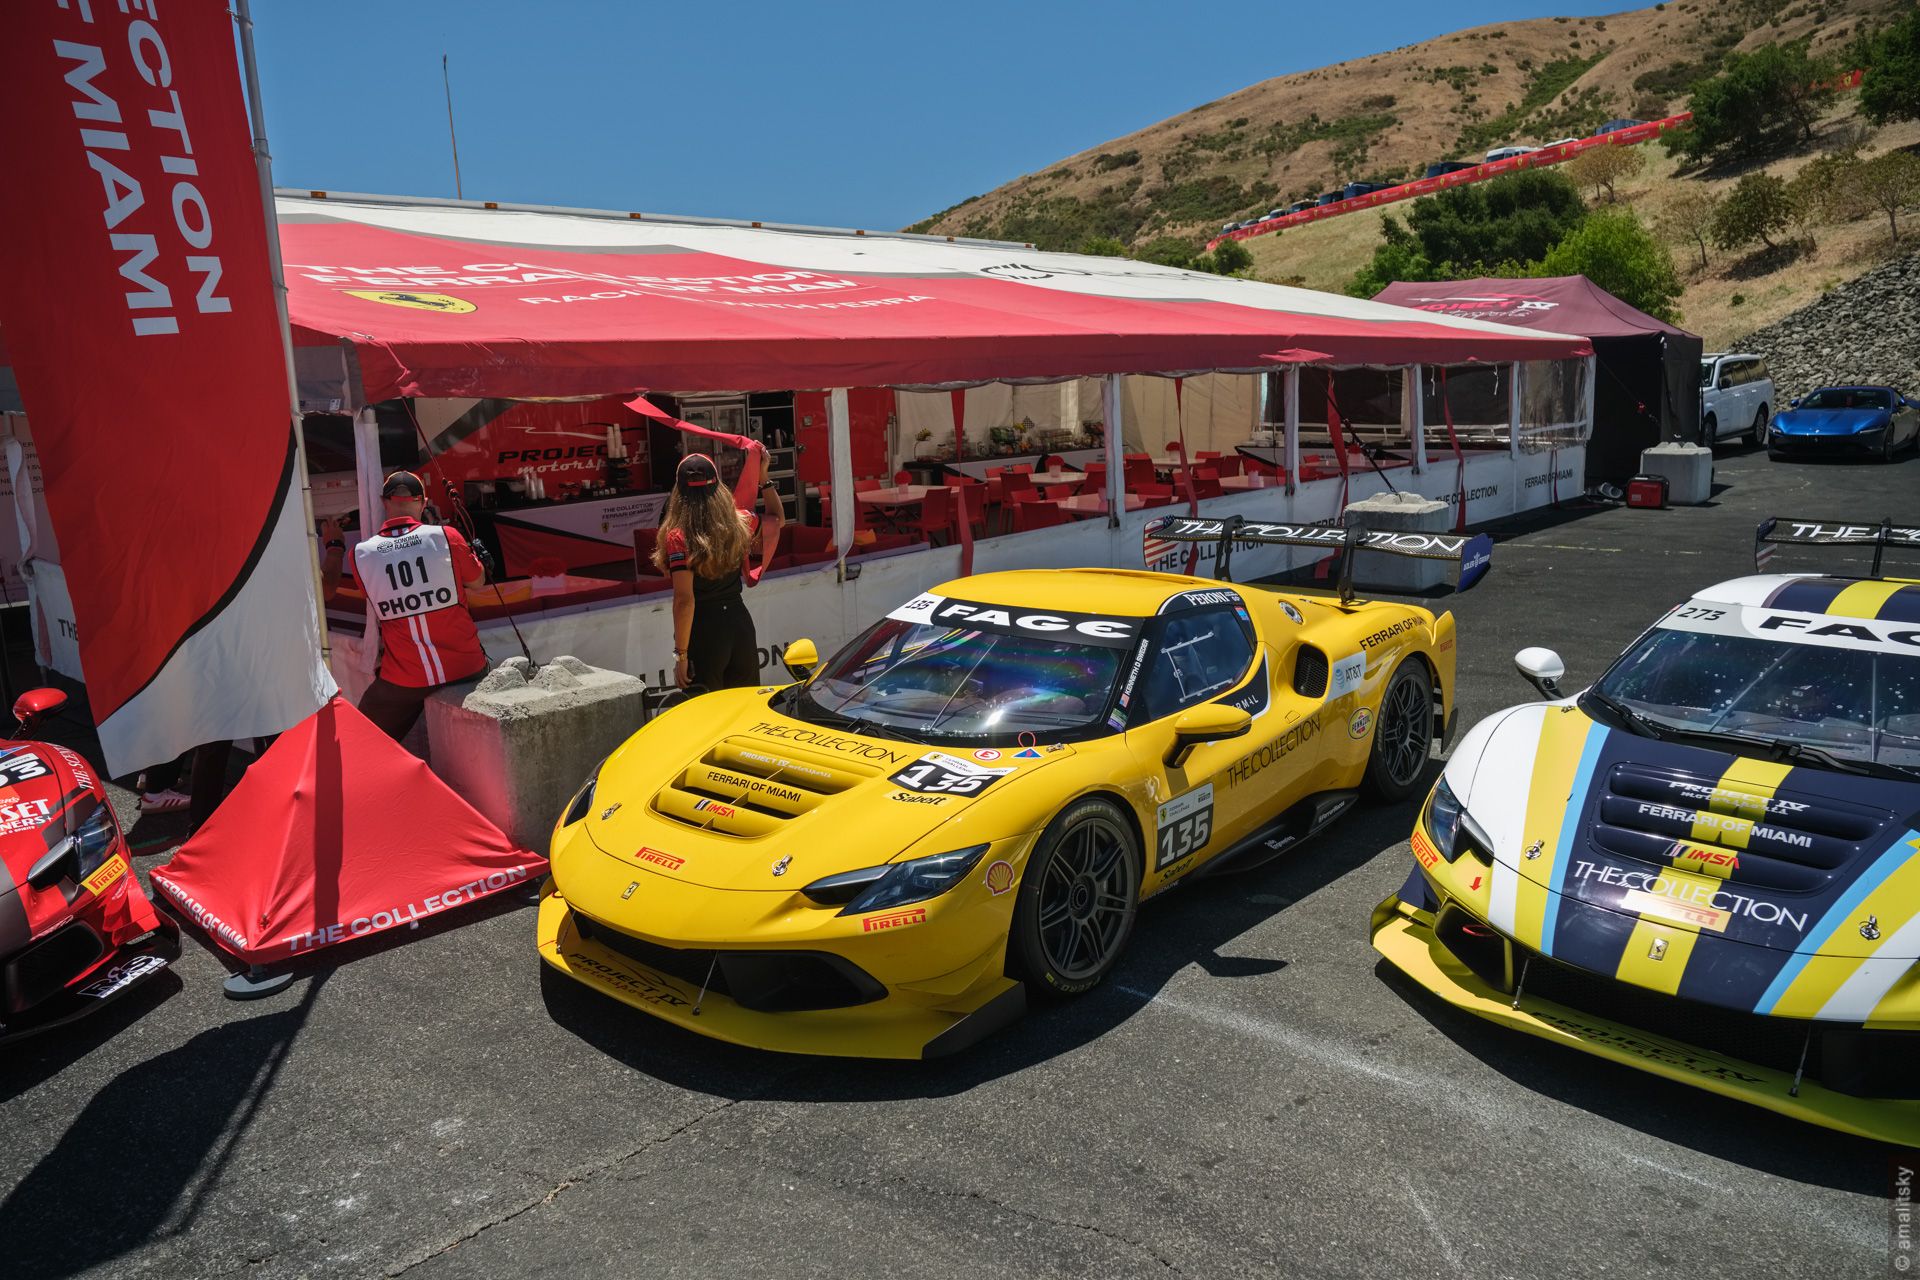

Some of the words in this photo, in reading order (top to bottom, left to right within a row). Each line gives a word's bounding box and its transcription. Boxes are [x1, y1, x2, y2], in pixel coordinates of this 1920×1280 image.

[52, 39, 180, 336] MIAMI
[498, 444, 632, 464] PROJEC
[1525, 474, 1546, 489] FERRARI
[1451, 485, 1498, 505] COLECTION
[394, 534, 419, 545] SONOMA
[1792, 523, 1870, 538] THE
[394, 538, 423, 550] RACEWAY
[1180, 541, 1264, 567] CLLTION
[385, 556, 429, 591] 101
[377, 587, 452, 617] PHOTO
[904, 599, 935, 611] 135
[1183, 591, 1230, 606] PERONI
[938, 603, 1132, 638] FAGE
[1677, 607, 1727, 621] 273
[1359, 622, 1404, 651] FERRARI
[1403, 618, 1413, 630] OF
[1125, 665, 1140, 696] KENNETH
[1345, 664, 1362, 682] AT&T
[739, 751, 778, 765] PROJECT
[980, 750, 994, 758] E
[707, 771, 750, 789] FERRARI
[750, 782, 767, 792] OF
[766, 785, 802, 803] MIAMI
[897, 764, 993, 793] 135
[892, 792, 947, 806] Sabelt
[1667, 781, 1775, 804] PROJECT
[1774, 799, 1811, 812] IV
[706, 802, 735, 819] IMSA
[1160, 810, 1209, 866] 135
[1638, 803, 1718, 828] FERRARI
[1720, 818, 1749, 833] OF
[1751, 825, 1812, 848] MIAMI
[634, 846, 686, 871] PIRELLI
[1411, 831, 1439, 869] PIRELLI
[1687, 849, 1740, 870] IMSA
[88, 858, 124, 891] PIRELLI
[282, 921, 346, 952] THE
[350, 866, 527, 938] COLLECTION
[862, 907, 927, 933] PIRELLI
[569, 953, 660, 995] PROJECT
[656, 991, 691, 1008] IV
